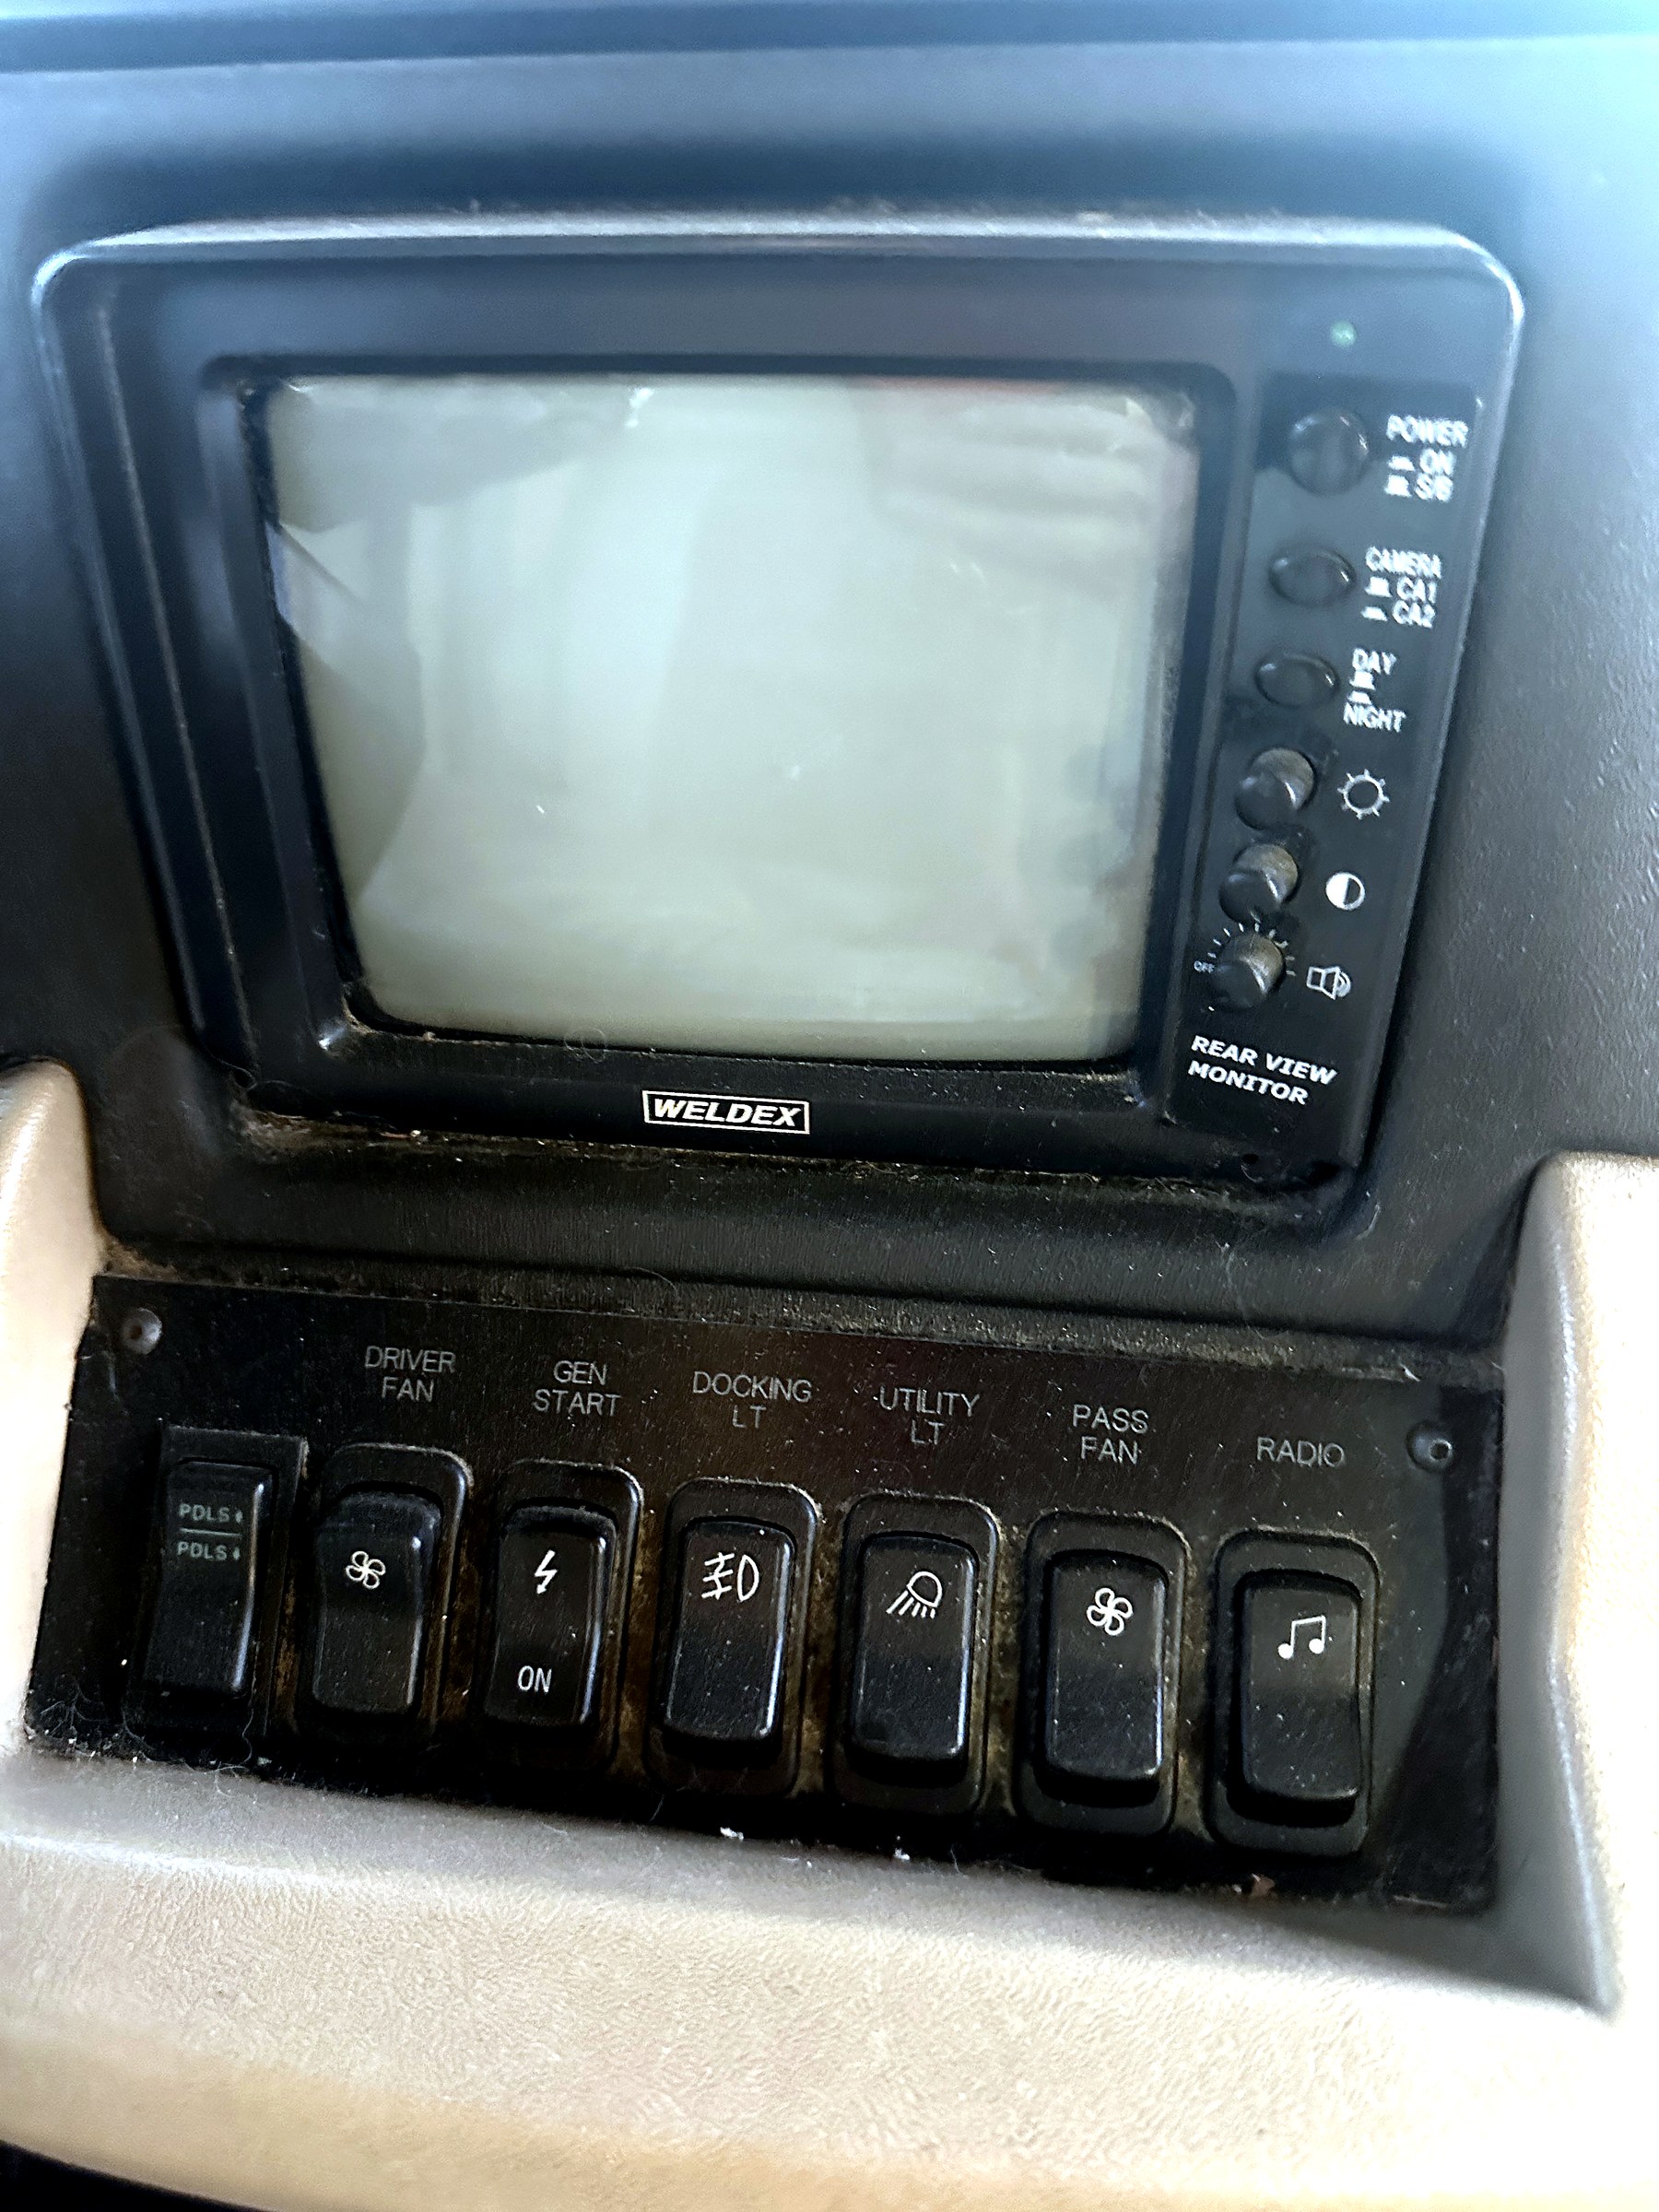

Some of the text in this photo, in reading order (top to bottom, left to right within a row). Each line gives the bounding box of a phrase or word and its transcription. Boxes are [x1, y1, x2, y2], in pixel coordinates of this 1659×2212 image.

[1385, 414, 1469, 448] POWER
[1419, 448, 1455, 477] ON
[1365, 547, 1442, 580] CAMERA
[1396, 575, 1438, 604] CA1
[1392, 599, 1436, 629] CA2
[1352, 648, 1397, 676] DAY
[1343, 702, 1406, 732] NIGHT
[1191, 1035, 1337, 1086] REAR VIEW
[1189, 1061, 1309, 1105] MONITOR
[654, 1098, 801, 1126] WELDEX
[365, 1346, 456, 1372] DRIVER
[553, 1360, 606, 1386] GEN
[382, 1377, 434, 1403] FAN
[692, 1371, 813, 1404] DOCKING
[879, 1387, 980, 1417] UTILITY
[533, 1388, 621, 1417] START
[732, 1406, 764, 1430] LT
[912, 1420, 944, 1444] LT
[1072, 1404, 1148, 1434] PASS
[1081, 1436, 1139, 1466] FAN
[1256, 1436, 1345, 1467] RADIO
[518, 1665, 552, 1692] ON
